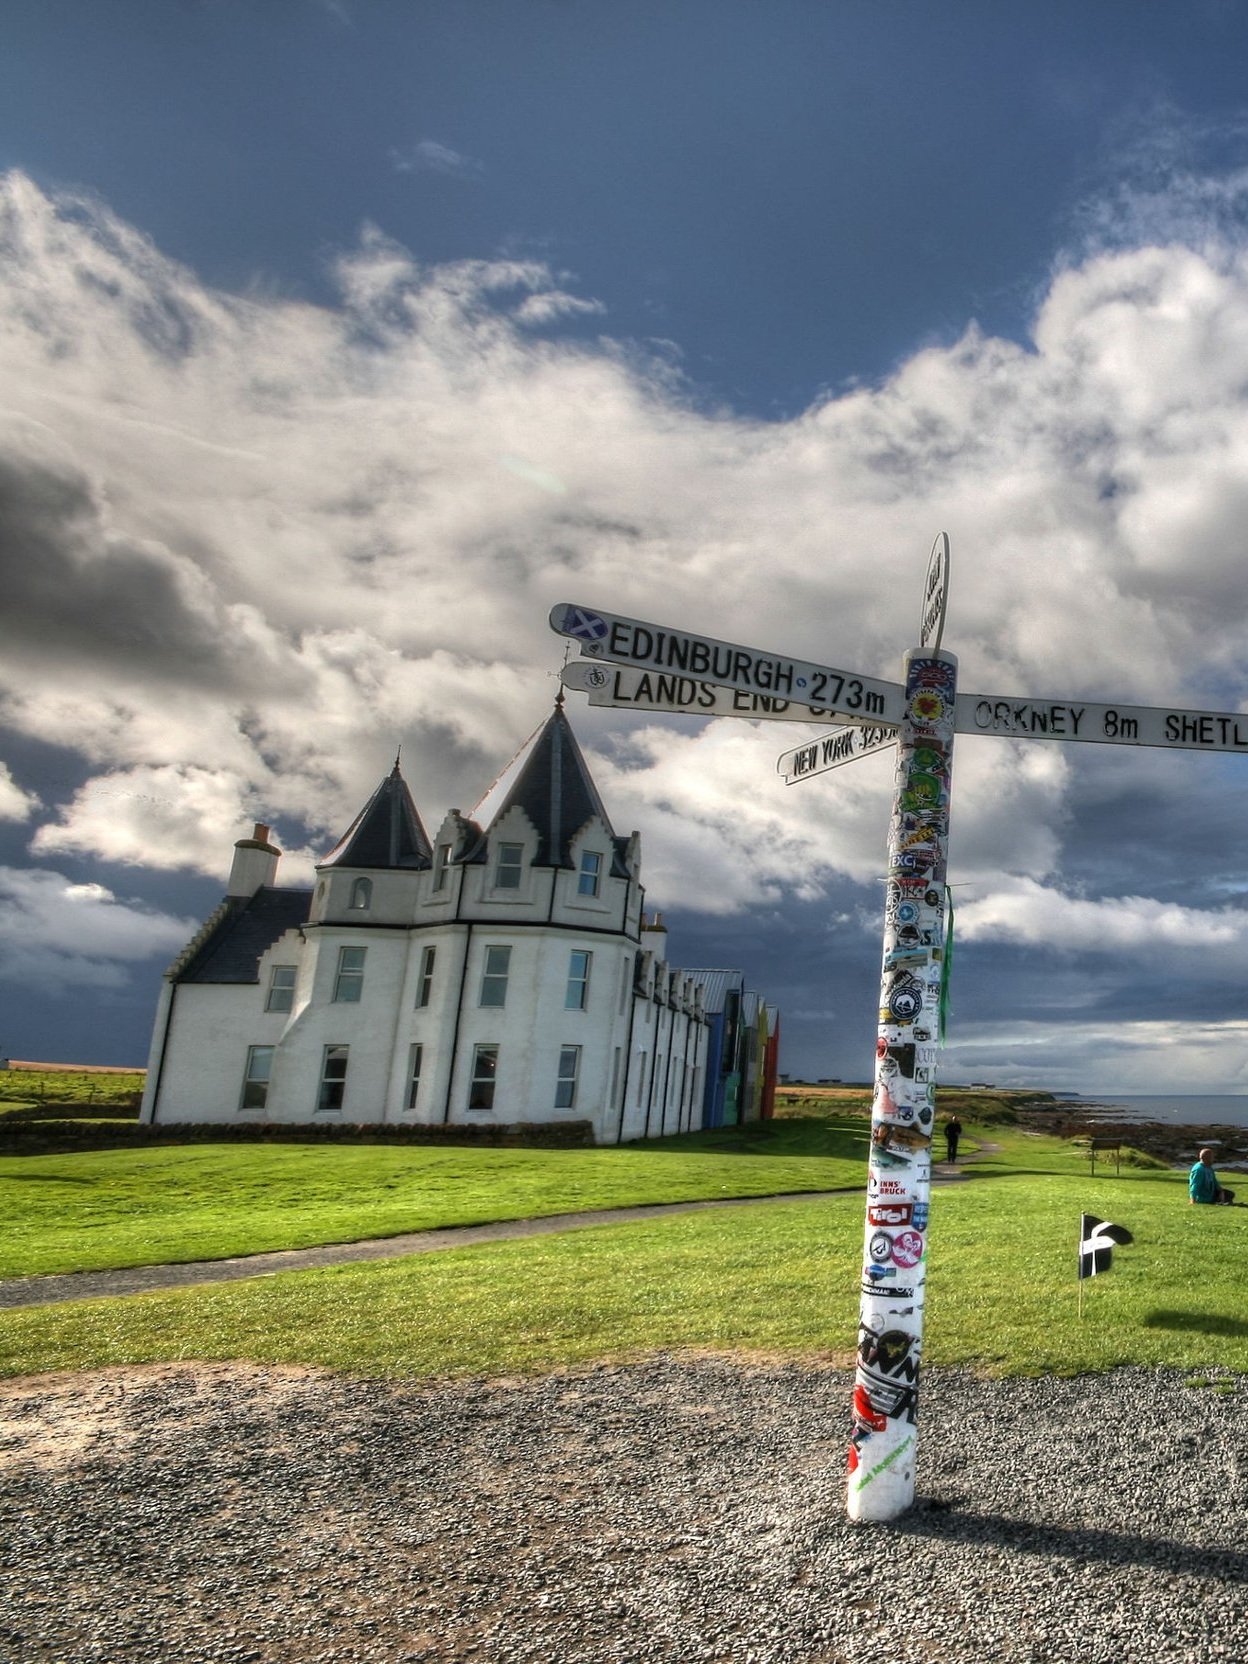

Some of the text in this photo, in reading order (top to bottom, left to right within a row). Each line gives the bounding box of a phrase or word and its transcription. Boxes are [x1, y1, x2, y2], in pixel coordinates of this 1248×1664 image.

[609, 621, 794, 695] EDINBURGH
[809, 671, 885, 714] 273m
[613, 670, 716, 708] LANDS
[733, 690, 790, 713] END
[975, 700, 1085, 736] ORKNEY
[1103, 709, 1139, 739] 8m
[793, 744, 818, 776] NEW
[822, 729, 855, 765] YORK
